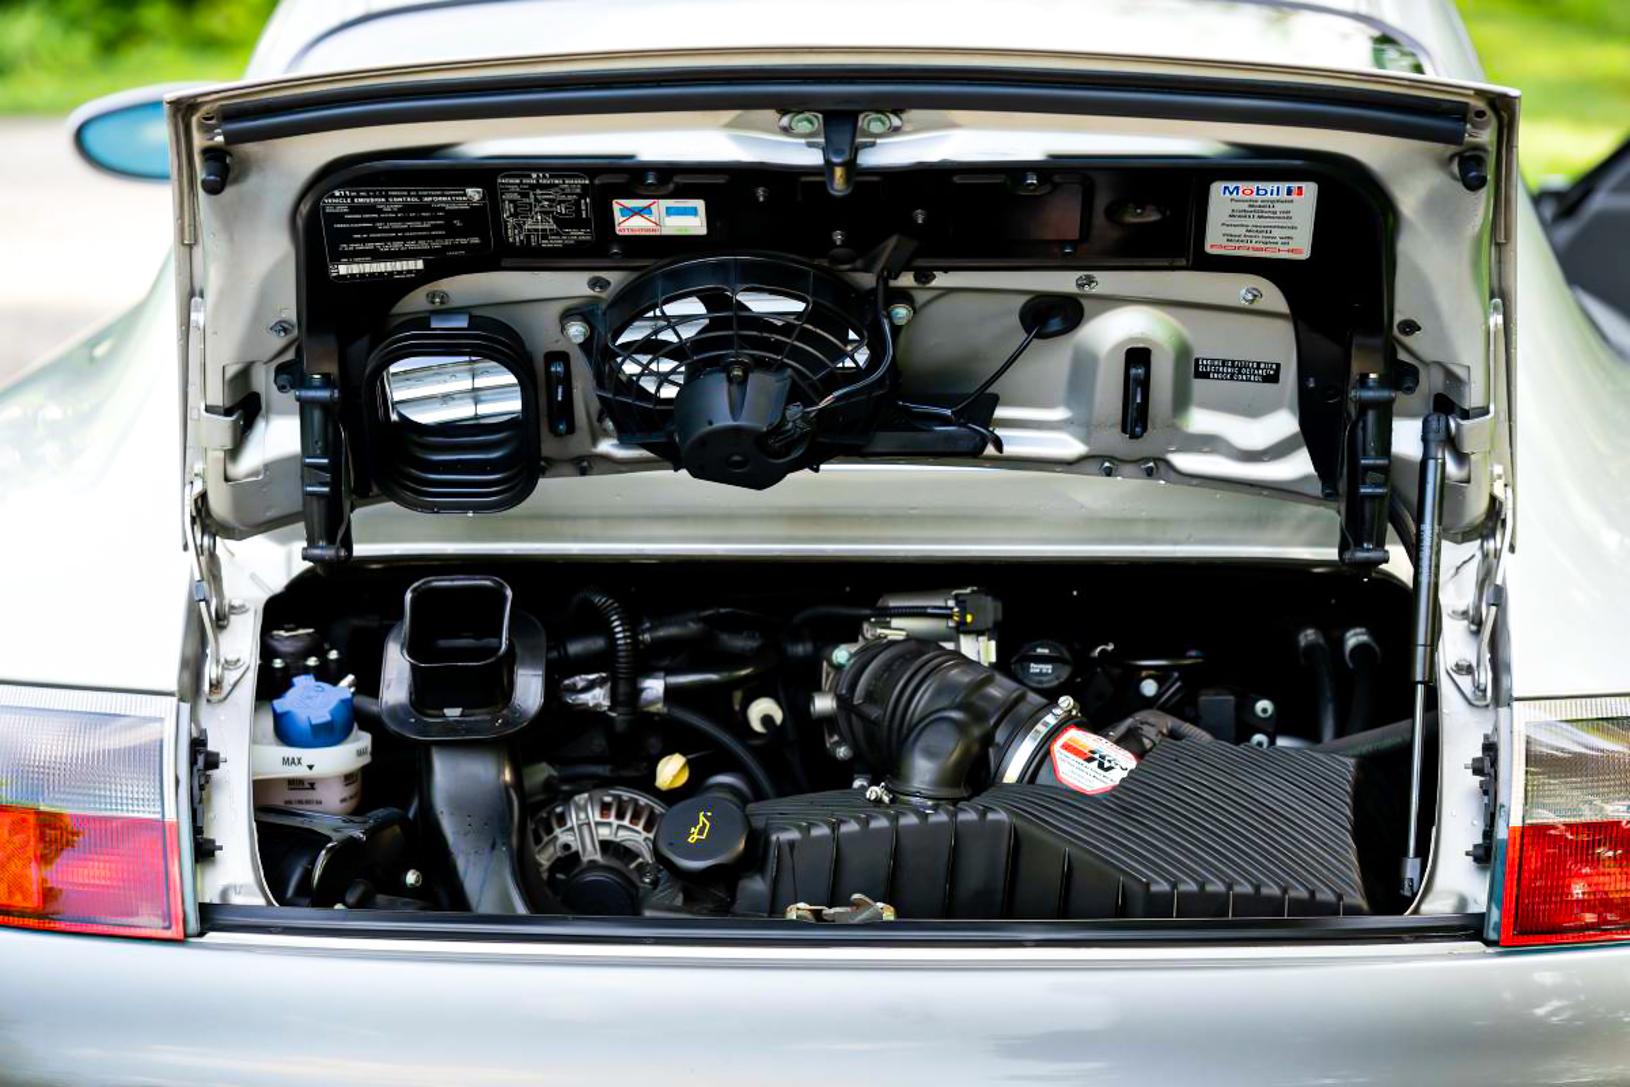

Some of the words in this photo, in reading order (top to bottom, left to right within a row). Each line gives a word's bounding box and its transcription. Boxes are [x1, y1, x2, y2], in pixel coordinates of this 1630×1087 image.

[1222, 185, 1280, 196] Mobil
[1210, 244, 1304, 254] PORSCHE
[1199, 365, 1240, 373] ELECTRONIC
[1260, 362, 1277, 370] WITH
[1233, 373, 1264, 382] CONTROL
[282, 756, 303, 767] MAX
